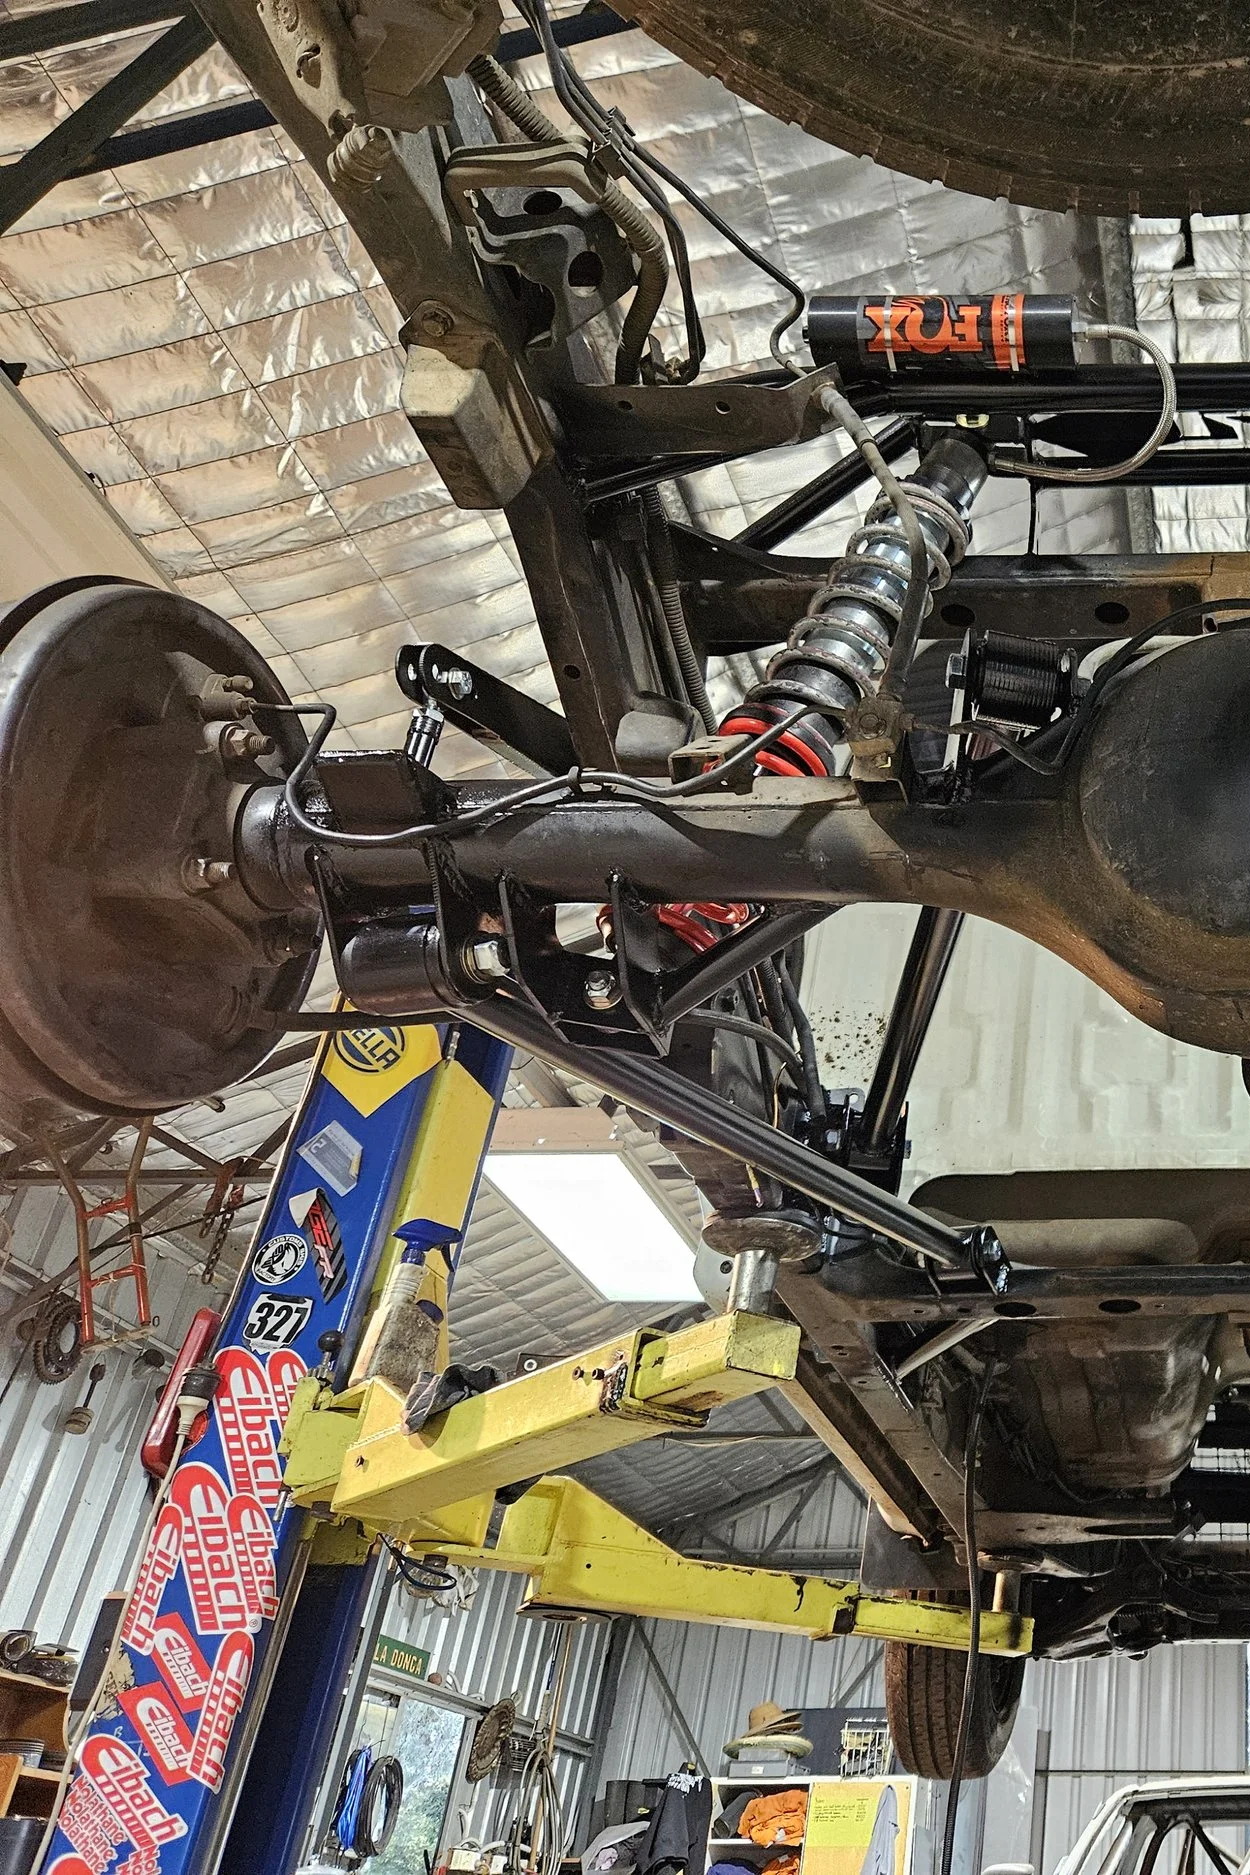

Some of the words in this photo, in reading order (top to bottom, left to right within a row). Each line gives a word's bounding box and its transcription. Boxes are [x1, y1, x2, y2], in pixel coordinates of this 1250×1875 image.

[866, 298, 983, 354] FOX
[351, 1028, 401, 1070] ELLA
[244, 1301, 309, 1344] 327
[205, 1348, 285, 1504] Eibach
[125, 1506, 183, 1649] Eibach
[171, 1465, 248, 1630] Eibach
[228, 1495, 278, 1616] Eibach
[155, 1628, 210, 1697] Eibach
[136, 1697, 192, 1769] Eibach
[196, 1631, 253, 1786] Eibach
[67, 1790, 115, 1861] Nolathane
[73, 1776, 126, 1845] Nolathane
[82, 1737, 180, 1843] Eibach
